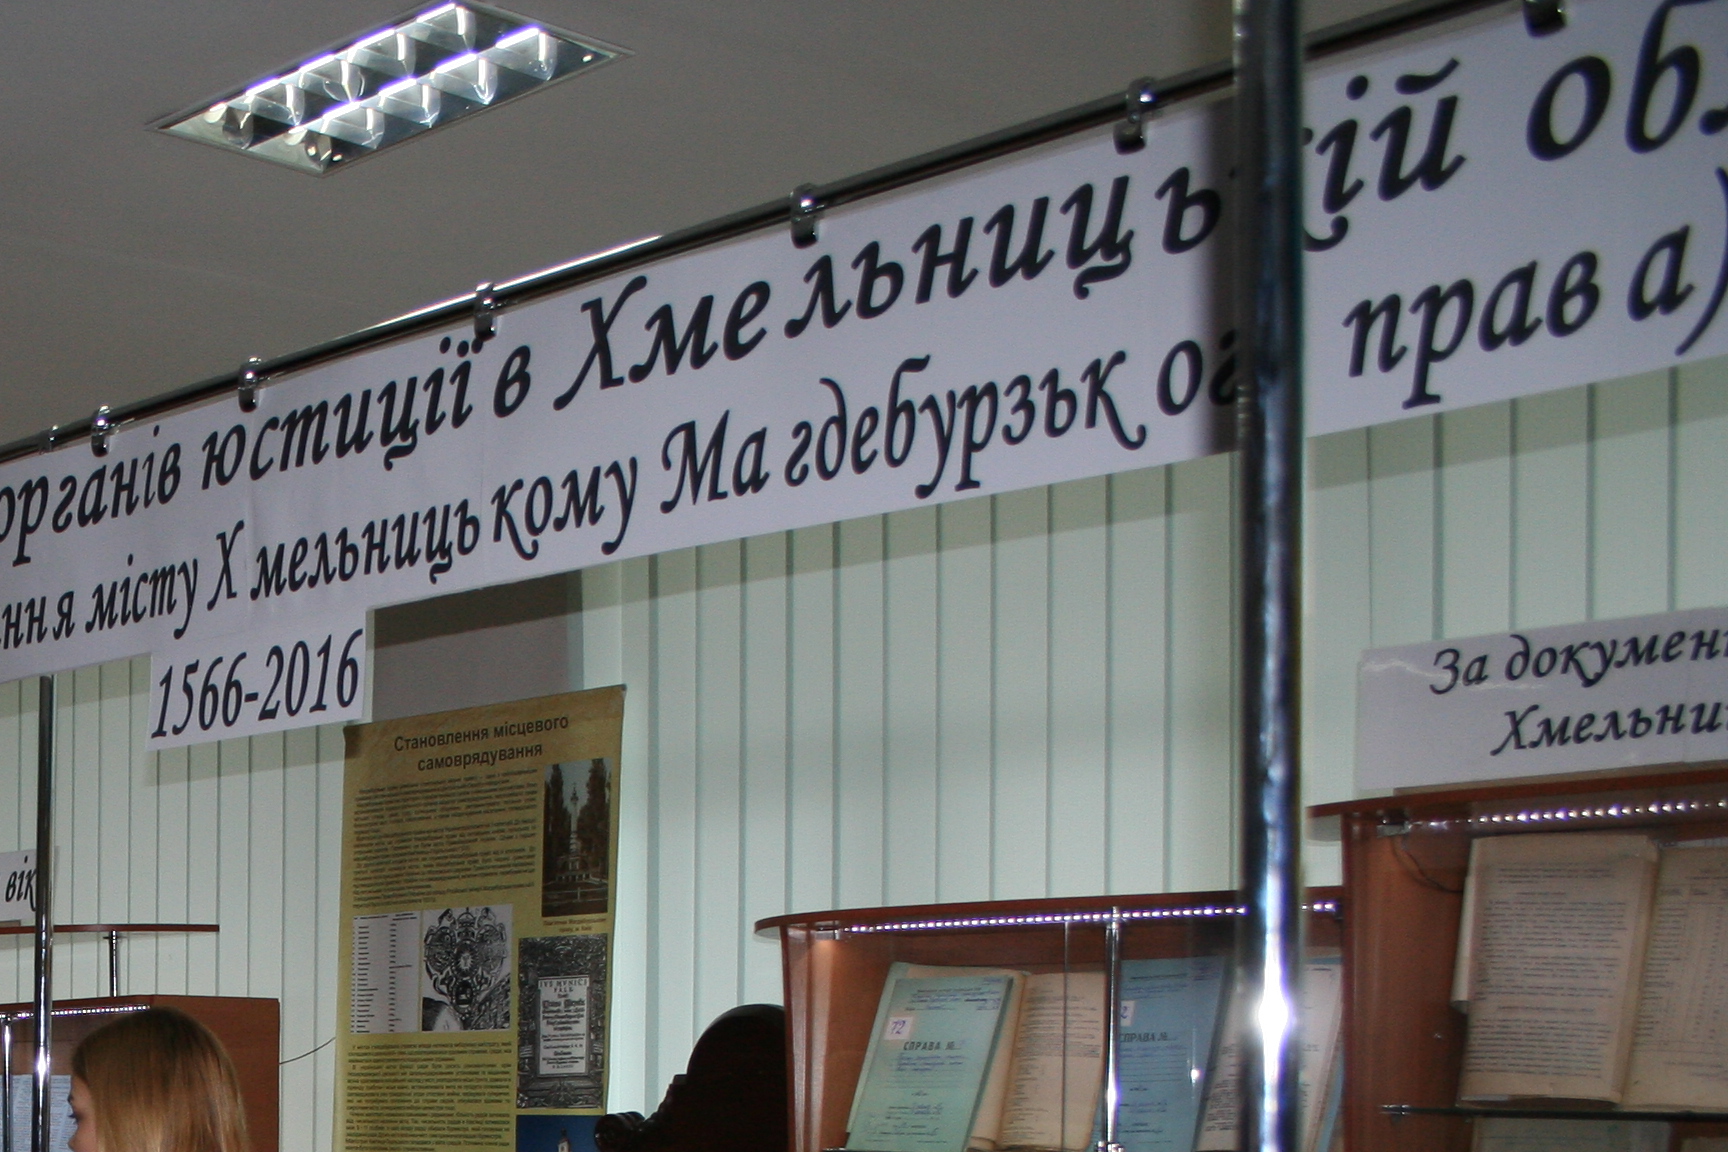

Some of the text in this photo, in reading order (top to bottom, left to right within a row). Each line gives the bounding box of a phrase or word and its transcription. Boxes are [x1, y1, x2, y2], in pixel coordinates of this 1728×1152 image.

[202, 337, 485, 490] юстиції
[494, 343, 534, 418] в
[554, 59, 1466, 410] Хмельницьій
[1527, 0, 1728, 163] об
[86, 554, 199, 640] місту
[208, 455, 638, 612] Хмельницькому
[660, 331, 1238, 515] Магдебурзьког
[1343, 167, 1728, 410] права)
[150, 628, 363, 740] 1566-2016
[1429, 628, 1728, 695] За докумен
[394, 715, 569, 752] Становлення місцевого
[418, 743, 542, 771] самоврядування
[1490, 702, 1728, 757] Хмельни
[5, 856, 37, 912] вік
[903, 1041, 940, 1051] СПРАВА
